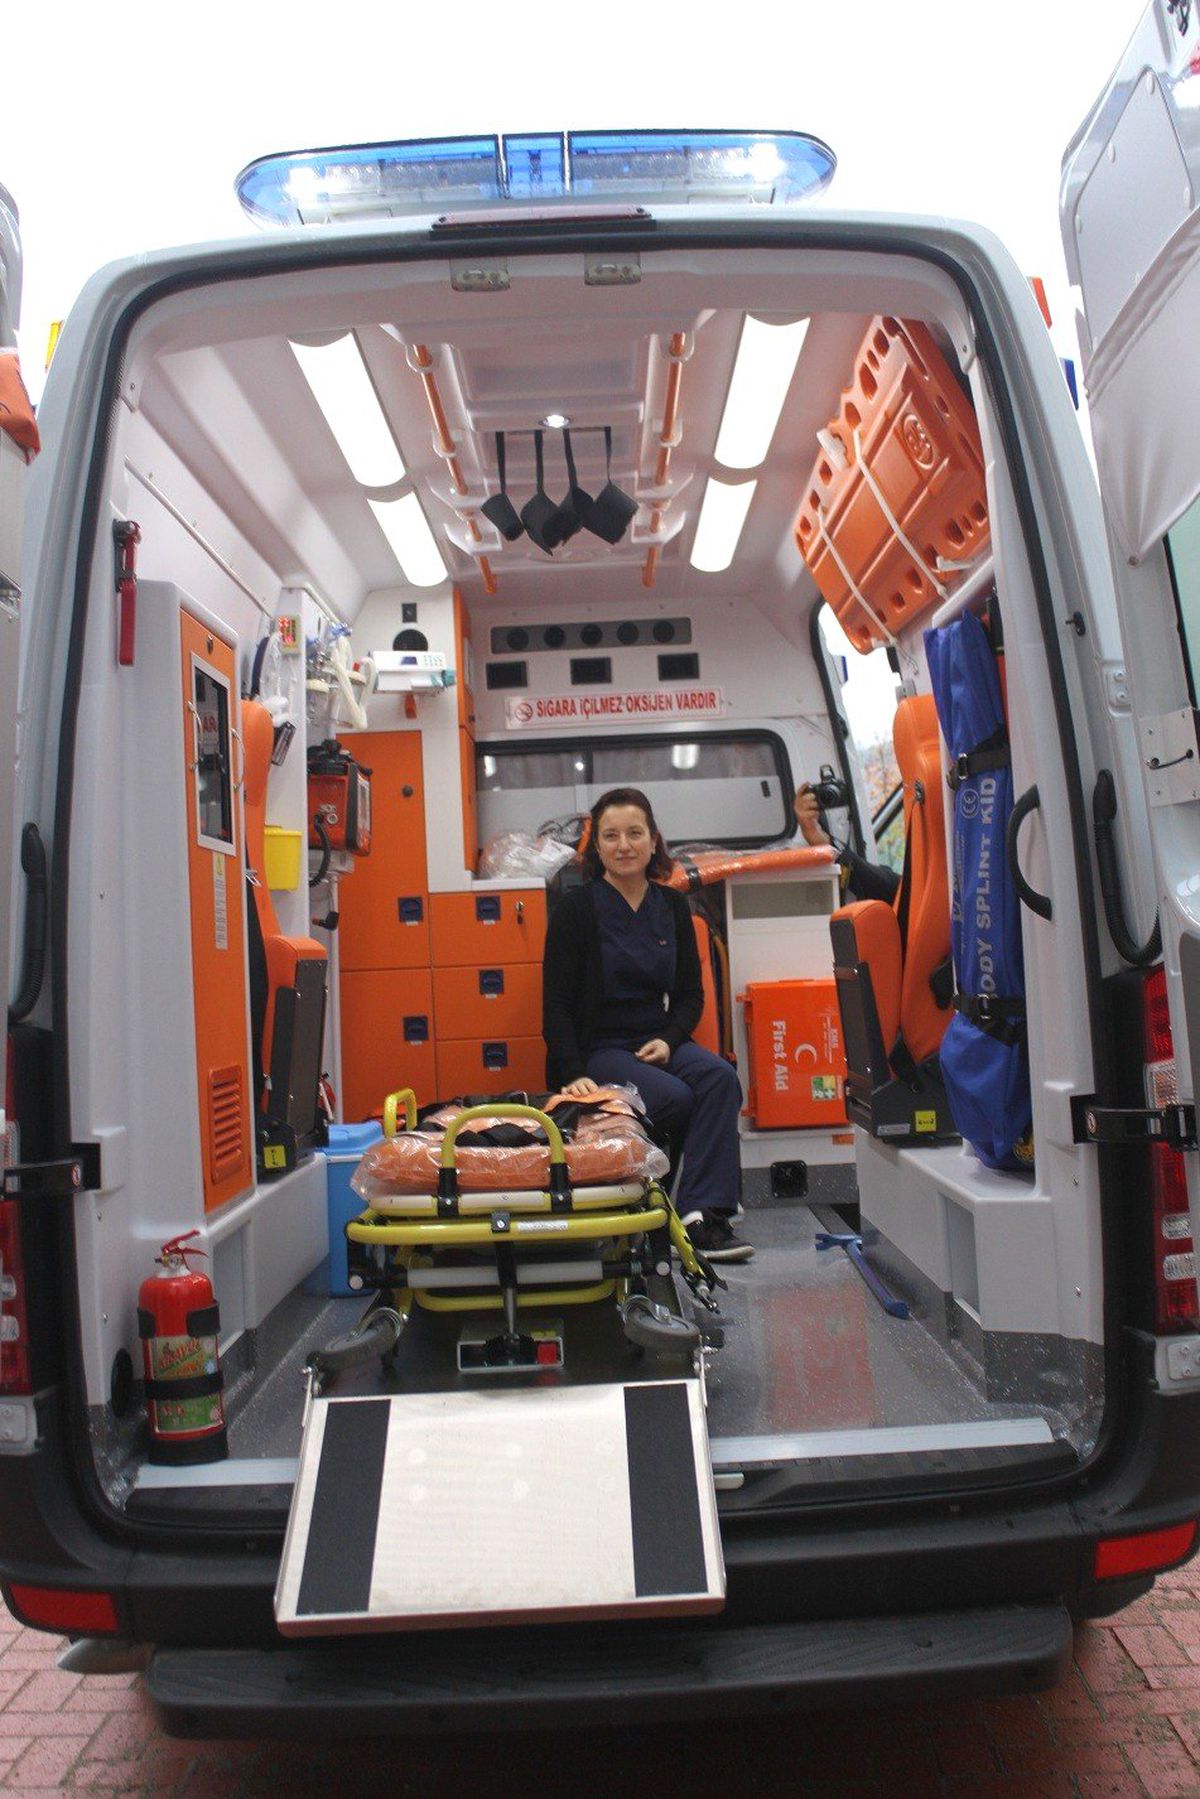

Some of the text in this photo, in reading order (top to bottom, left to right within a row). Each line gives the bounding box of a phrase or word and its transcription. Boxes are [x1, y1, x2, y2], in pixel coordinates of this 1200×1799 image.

[676, 691, 716, 709] VARDIR
[976, 778, 997, 998] ODY SPLINT KID
[772, 1020, 789, 1092] First Aid
